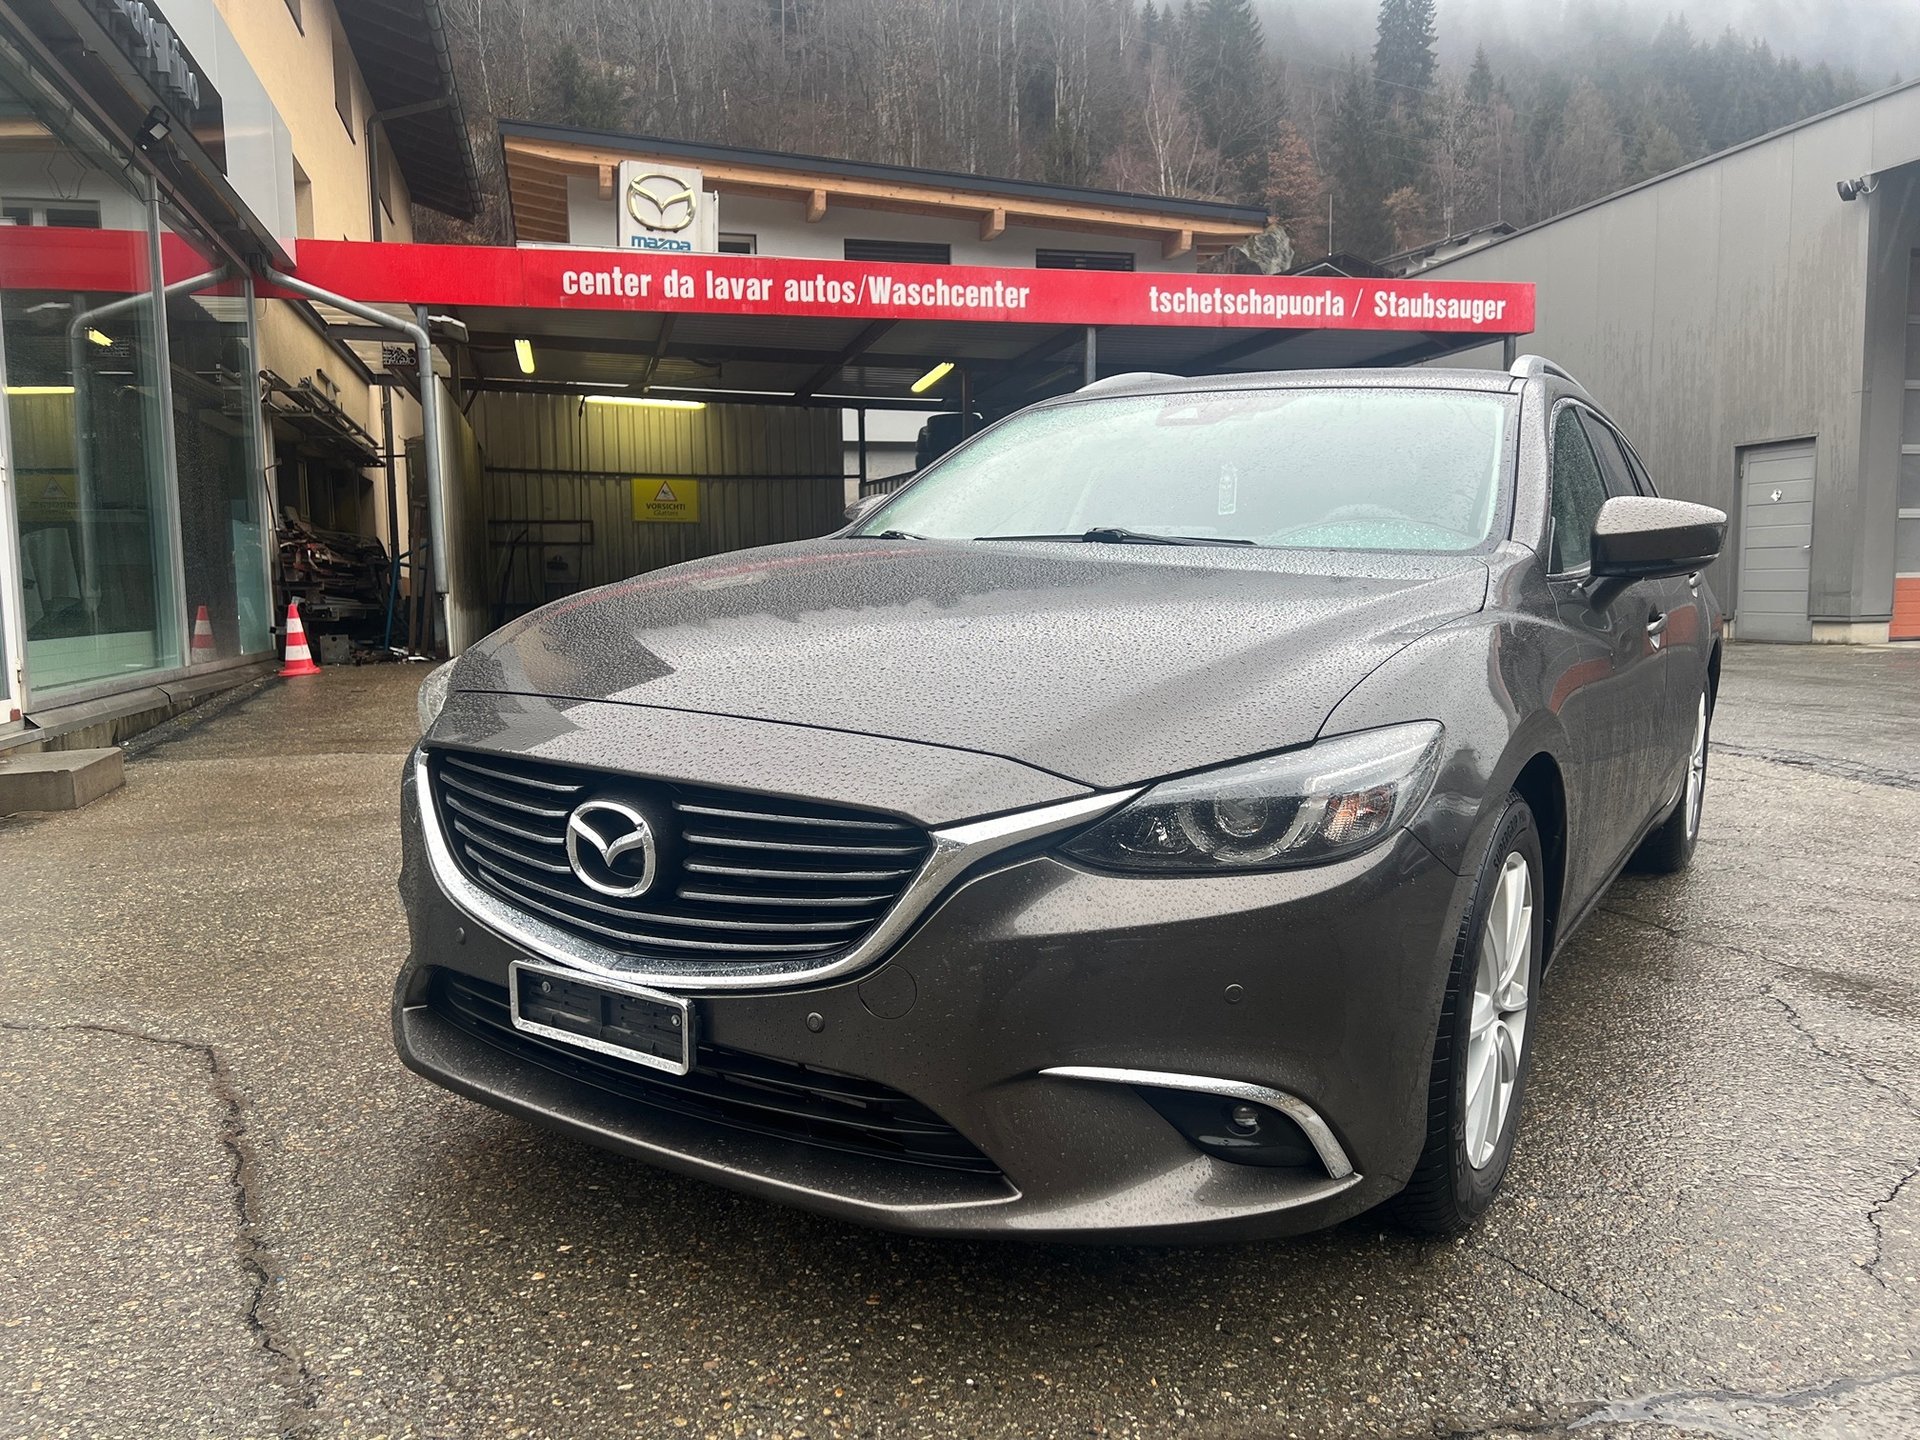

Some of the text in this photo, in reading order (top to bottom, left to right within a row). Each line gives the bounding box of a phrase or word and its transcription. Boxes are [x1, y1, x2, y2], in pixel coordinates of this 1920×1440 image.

[562, 266, 652, 297] center
[663, 269, 695, 299] da
[705, 270, 774, 301] lavar
[1149, 286, 1345, 319] tschetschapuorla
[1373, 290, 1506, 324] Staubsauger
